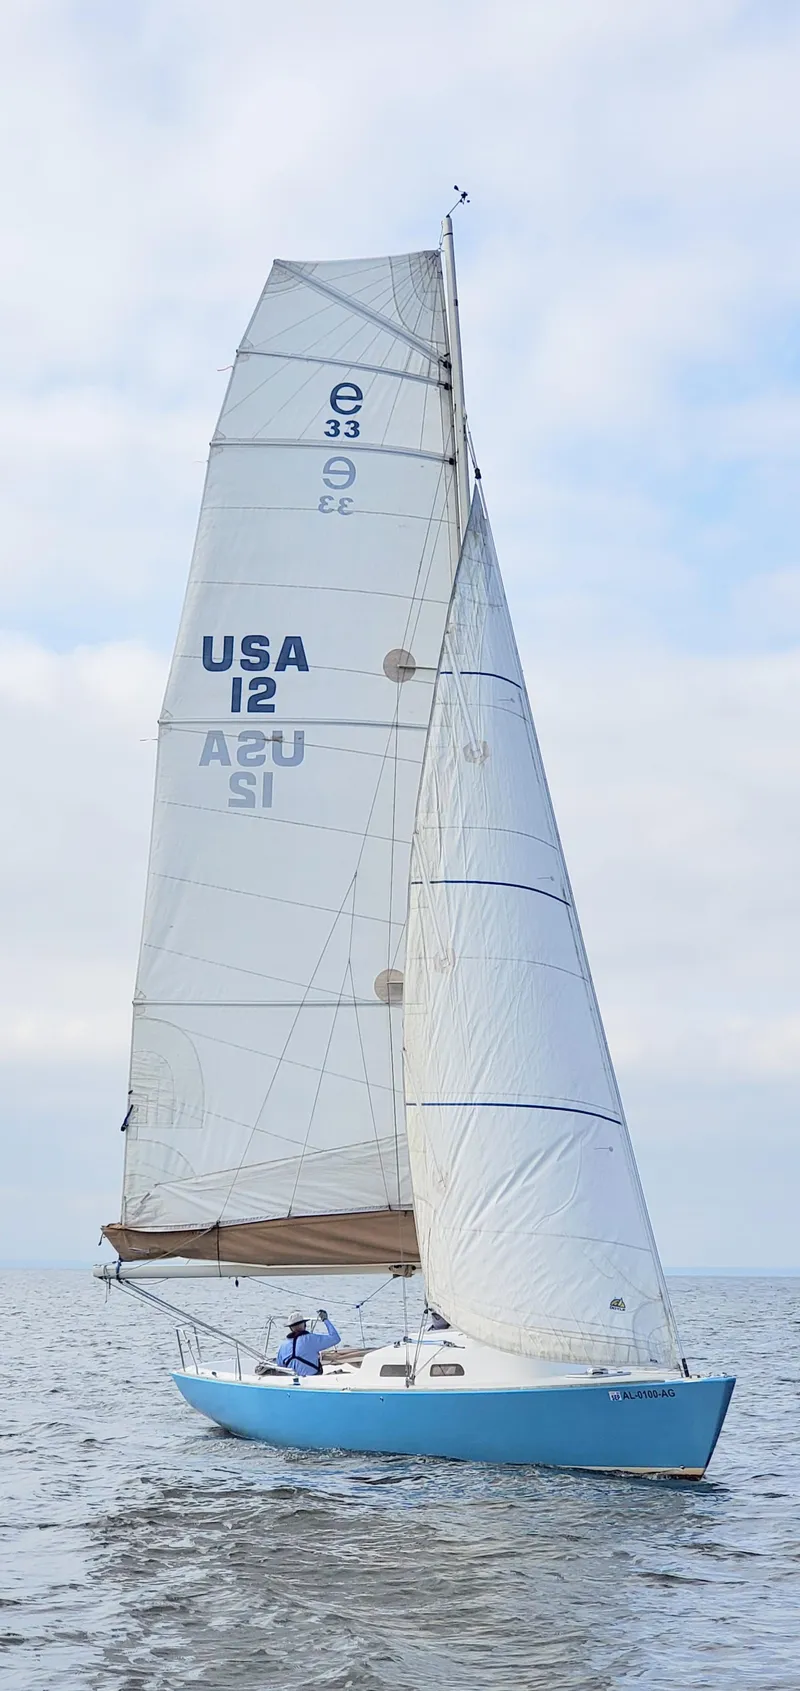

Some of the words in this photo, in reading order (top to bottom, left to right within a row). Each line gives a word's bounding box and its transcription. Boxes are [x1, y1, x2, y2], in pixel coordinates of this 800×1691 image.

[330, 382, 363, 415] e
[324, 419, 360, 438] 33
[202, 635, 309, 672] USA
[231, 677, 276, 713] 12
